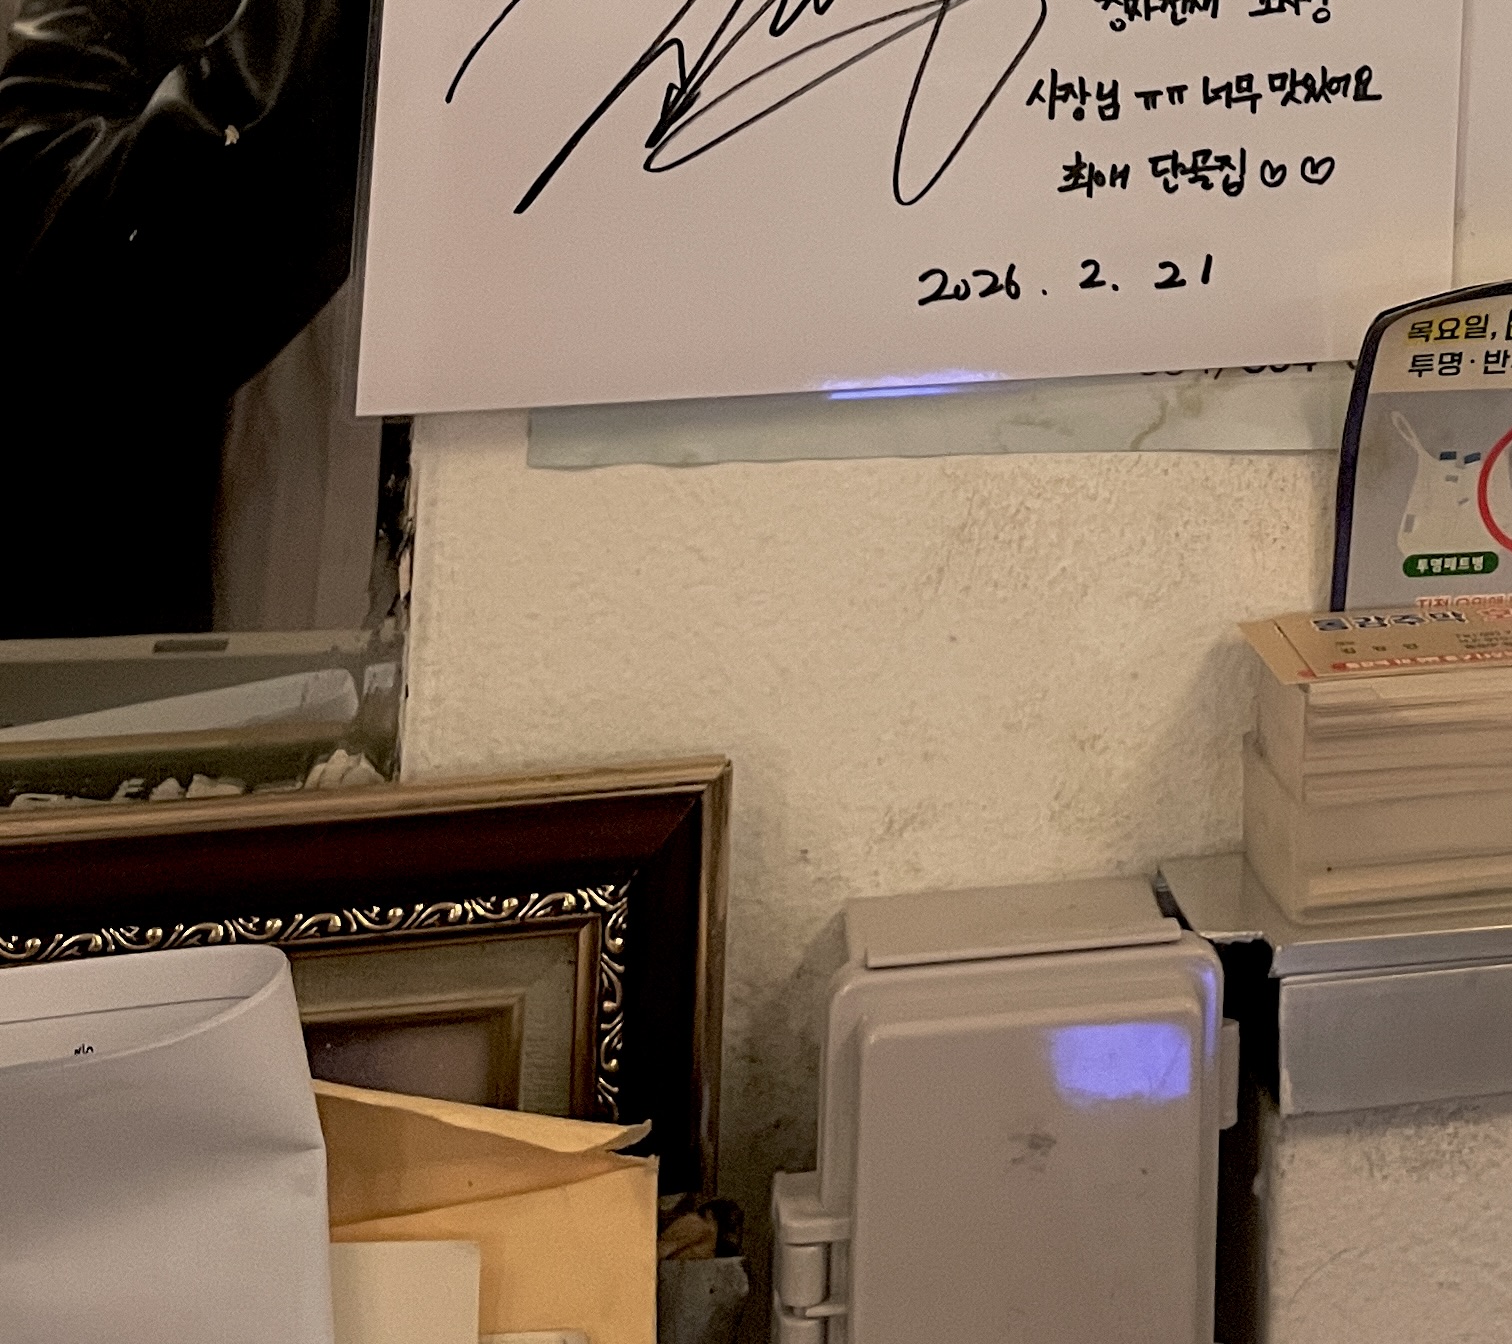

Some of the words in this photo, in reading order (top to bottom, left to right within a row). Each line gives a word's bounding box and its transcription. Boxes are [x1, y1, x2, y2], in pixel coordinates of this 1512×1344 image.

[1025, 67, 1121, 122] 사장님
[1201, 72, 1263, 115] 너무
[1056, 150, 1131, 199] 최애
[1406, 314, 1497, 343] 목요일,
